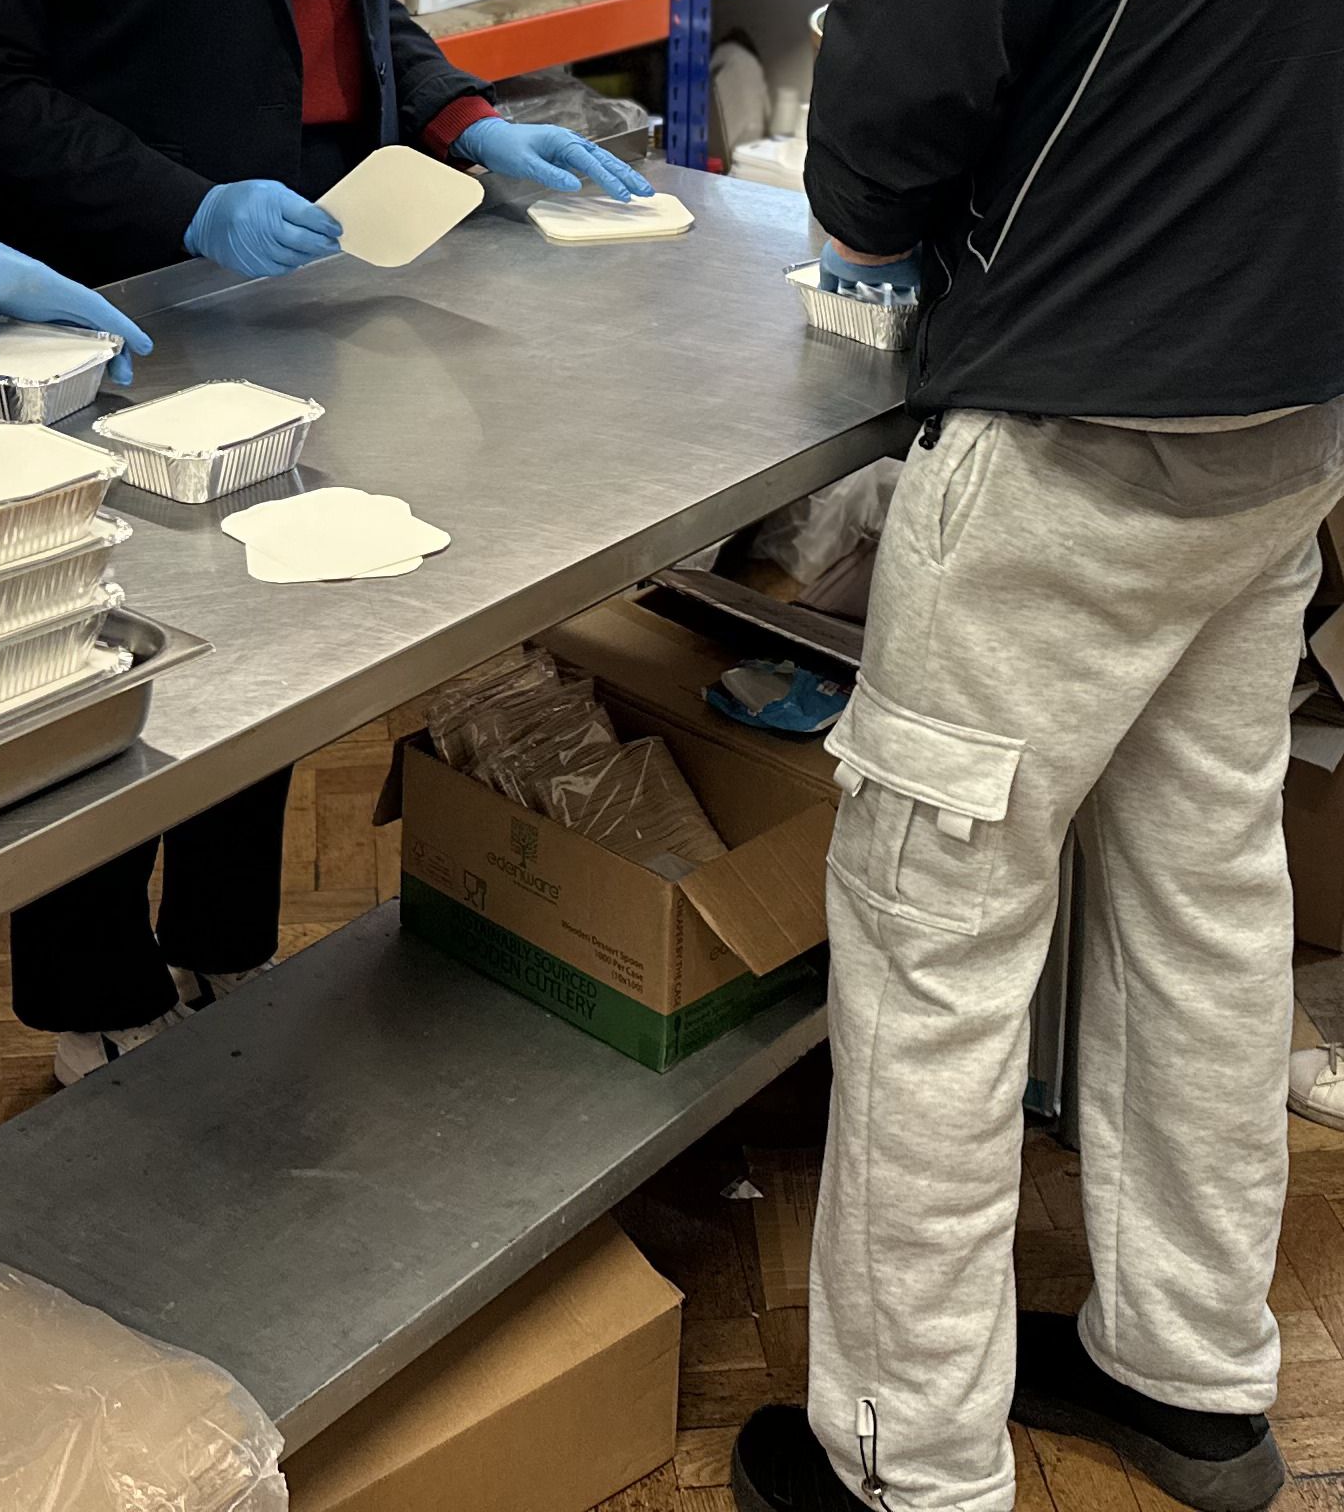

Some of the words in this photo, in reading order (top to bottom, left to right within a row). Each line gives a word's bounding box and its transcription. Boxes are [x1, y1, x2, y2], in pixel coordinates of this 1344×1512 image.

[486, 851, 561, 901] edenware
[561, 920, 590, 943] Wooden
[591, 934, 620, 957] Dessert
[620, 949, 645, 971] Spoon
[594, 948, 612, 965] 1000
[612, 959, 625, 973] Per
[625, 965, 644, 982] Case
[525, 966, 597, 1020] CUTLERY
[534, 950, 598, 999] SOURCED
